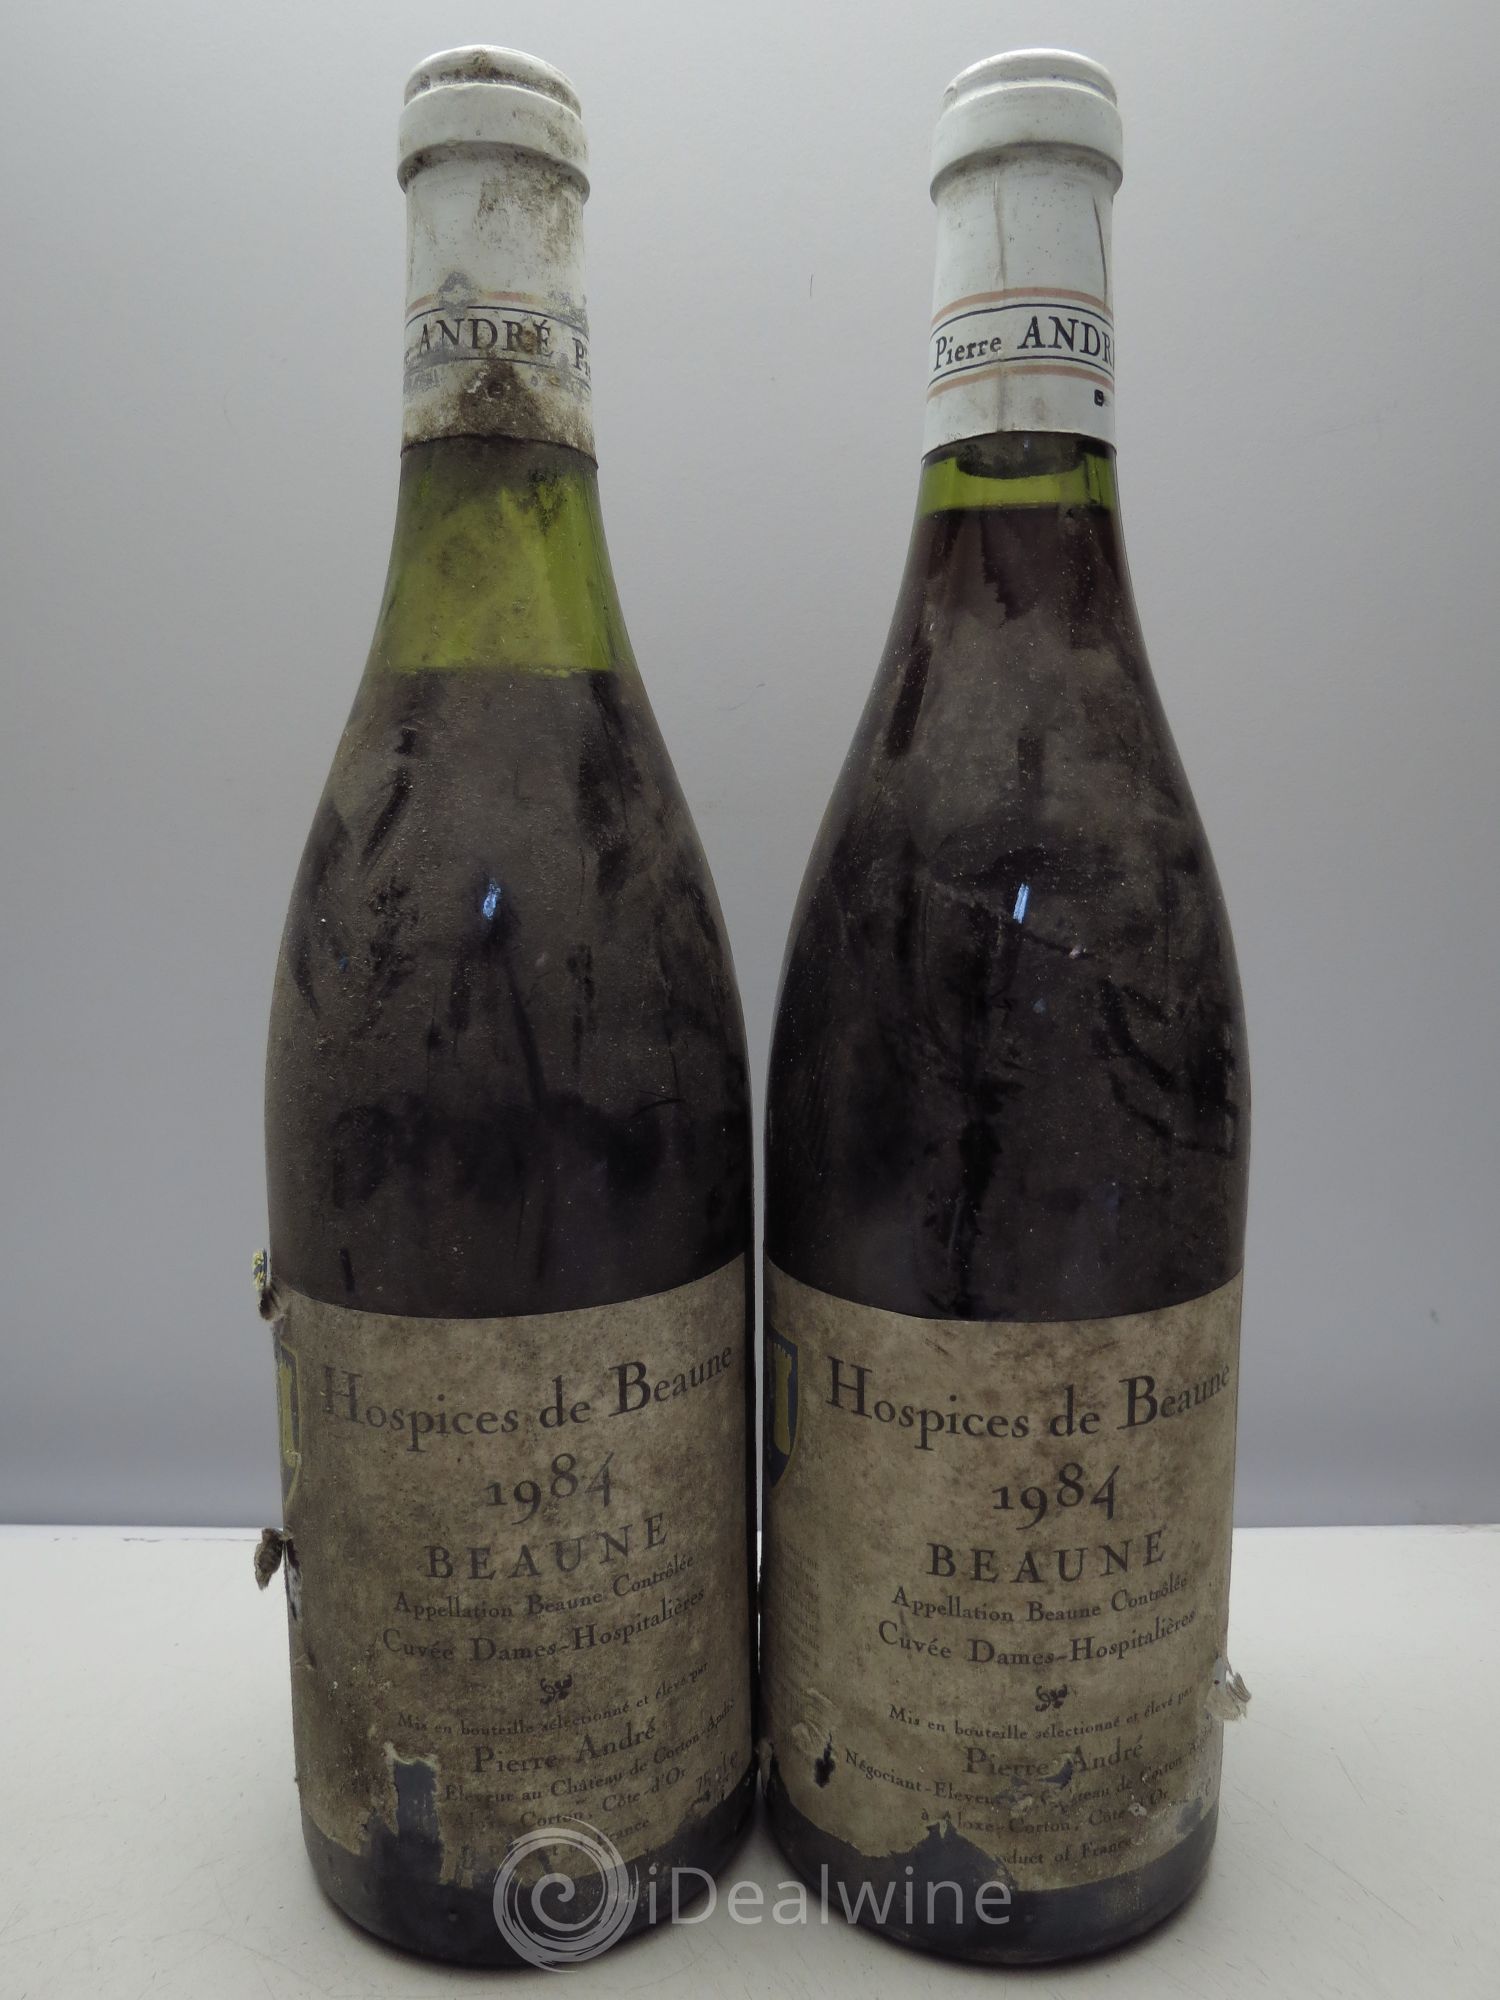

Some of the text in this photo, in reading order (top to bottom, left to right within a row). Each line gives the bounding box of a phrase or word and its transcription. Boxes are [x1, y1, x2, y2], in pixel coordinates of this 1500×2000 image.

[418, 317, 552, 357] ANDRÉ
[933, 315, 1114, 372] Pierre ANDR
[321, 1346, 732, 1452] Hospices de Beaune
[826, 1356, 1230, 1451] Hospices de Beaune
[486, 1452, 615, 1525] 1984
[992, 1462, 1121, 1531] 1984
[424, 1513, 668, 1580] BEAUNE
[926, 1530, 1165, 1583] BEAUNE
[394, 1555, 694, 1621] Appellation Beaune Contrôlée
[891, 1573, 1188, 1622] Appellation Beaune Contrôlée
[383, 1590, 705, 1663] Cuvée Dames-Hospitalières
[878, 1609, 1196, 1666] Cuvée Dames-Hospitalières
[635, 1694, 649, 1709] et
[888, 1703, 920, 1726] Mis
[927, 1721, 946, 1733] en
[954, 1719, 1029, 1740] bouteille
[1126, 1712, 1139, 1724] et
[472, 1715, 657, 1773] Pierre André
[629, 1757, 648, 1776] de
[961, 1734, 1144, 1776] Pierre André
[844, 1747, 1006, 1804] Négociant-Eleveu
[1053, 1847, 1070, 1863] of
